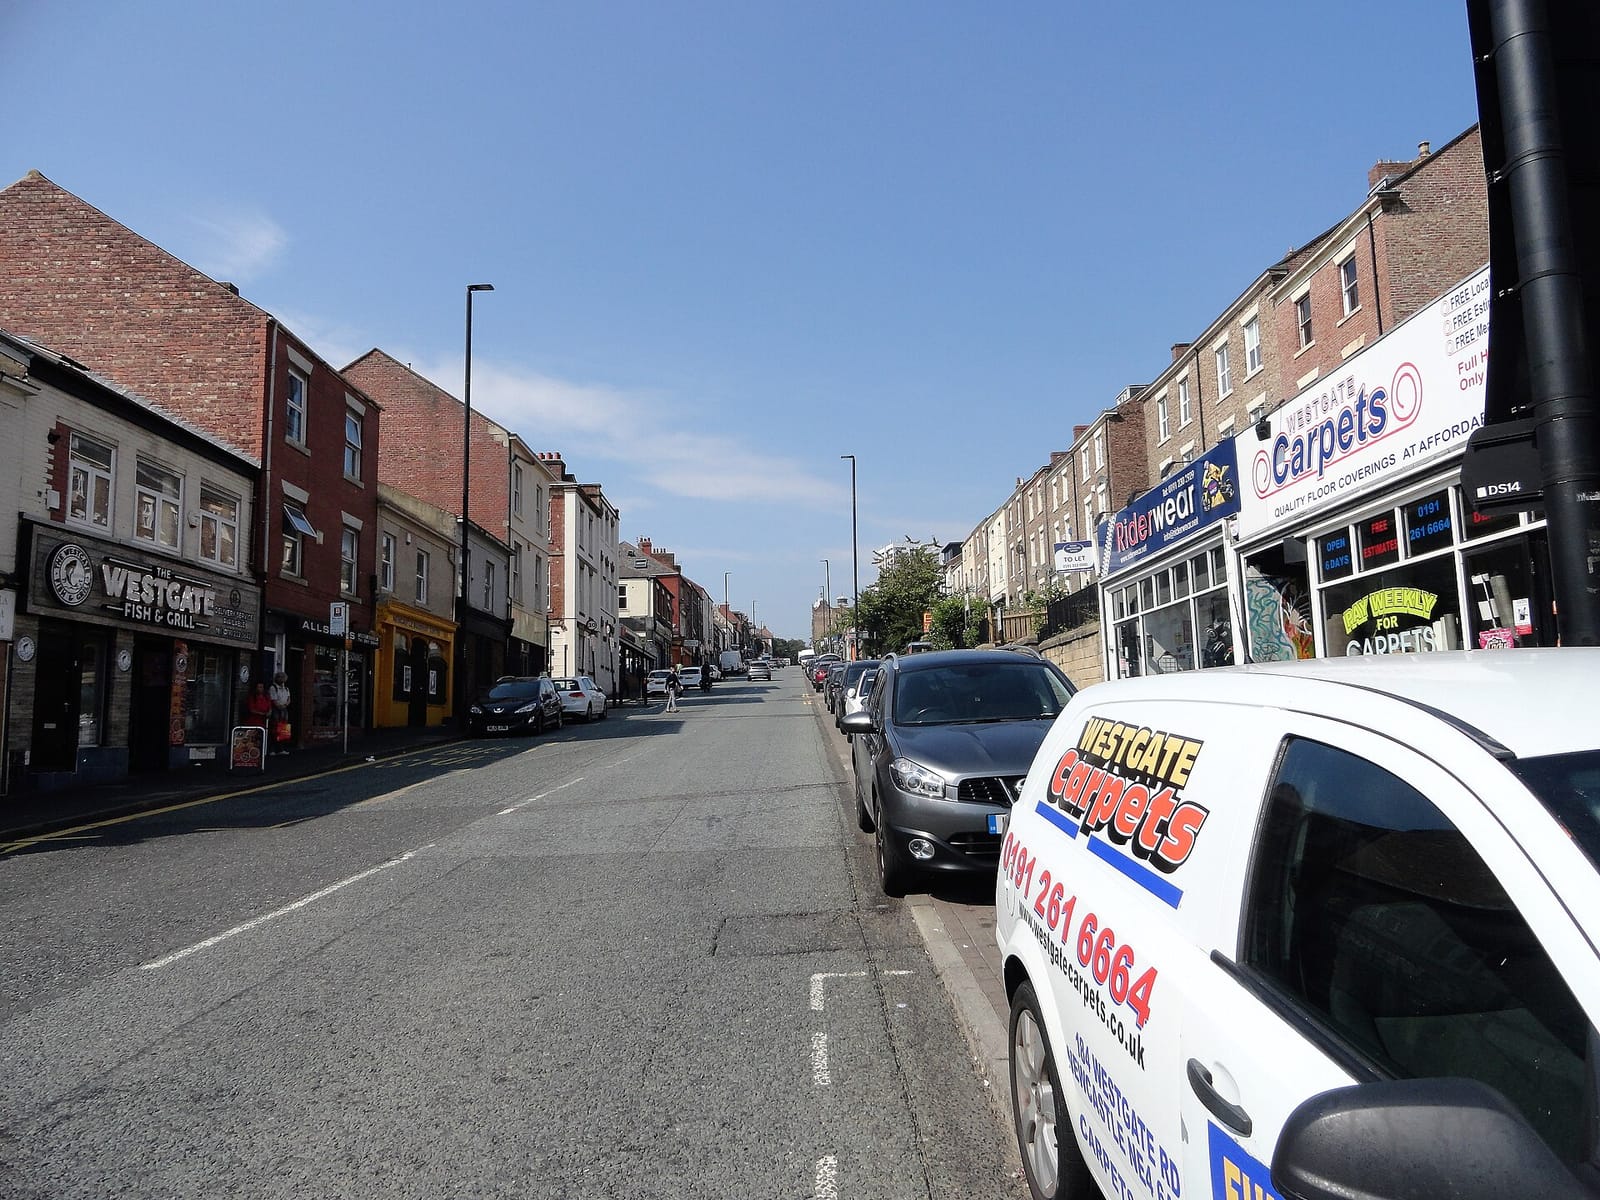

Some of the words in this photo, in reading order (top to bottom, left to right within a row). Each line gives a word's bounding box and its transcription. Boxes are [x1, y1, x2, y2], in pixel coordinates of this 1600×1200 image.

[1450, 288, 1470, 310] FREE
[1453, 307, 1473, 330] FREE
[1455, 328, 1475, 349] FREE
[1458, 354, 1477, 375] Full
[1460, 371, 1484, 391] Only
[1286, 375, 1355, 435] WESTGATE
[1273, 384, 1388, 486] Carpets
[1274, 495, 1306, 518] QUALITY
[1308, 481, 1336, 502] FLOOR
[1338, 453, 1396, 488] COVERINGS
[1403, 443, 1416, 460] AT
[1488, 482, 1521, 496] DS14
[1115, 484, 1194, 553] Riderwear
[1417, 500, 1440, 517] 0191
[1371, 519, 1389, 534] FREE
[1409, 526, 1426, 540] 261
[1427, 517, 1451, 534] 6664
[1326, 537, 1345, 552] OPEN
[156, 567, 171, 579] THE
[1330, 554, 1350, 569] DAYS
[102, 564, 216, 616] WESTGATE
[124, 602, 151, 621] FISH
[154, 609, 163, 623] &
[167, 611, 195, 629] GRILL
[1342, 595, 1368, 634] PAY
[1369, 587, 1438, 620] WEEKLY
[1376, 615, 1399, 631] FOR
[1078, 717, 1203, 789] WESTGATE
[1002, 832, 1037, 900] 0191
[1034, 869, 1077, 944] 261
[1077, 912, 1158, 1030] 6664
[1018, 900, 1146, 1071] www.westgatecarpets.co.uk
[1067, 1044, 1127, 1157] NEWCASTLE
[1127, 1136, 1154, 1198] NE4
[1075, 1031, 1092, 1071] 184
[1092, 1053, 1157, 1168] WESTGATE
[1159, 1145, 1181, 1199] RD
